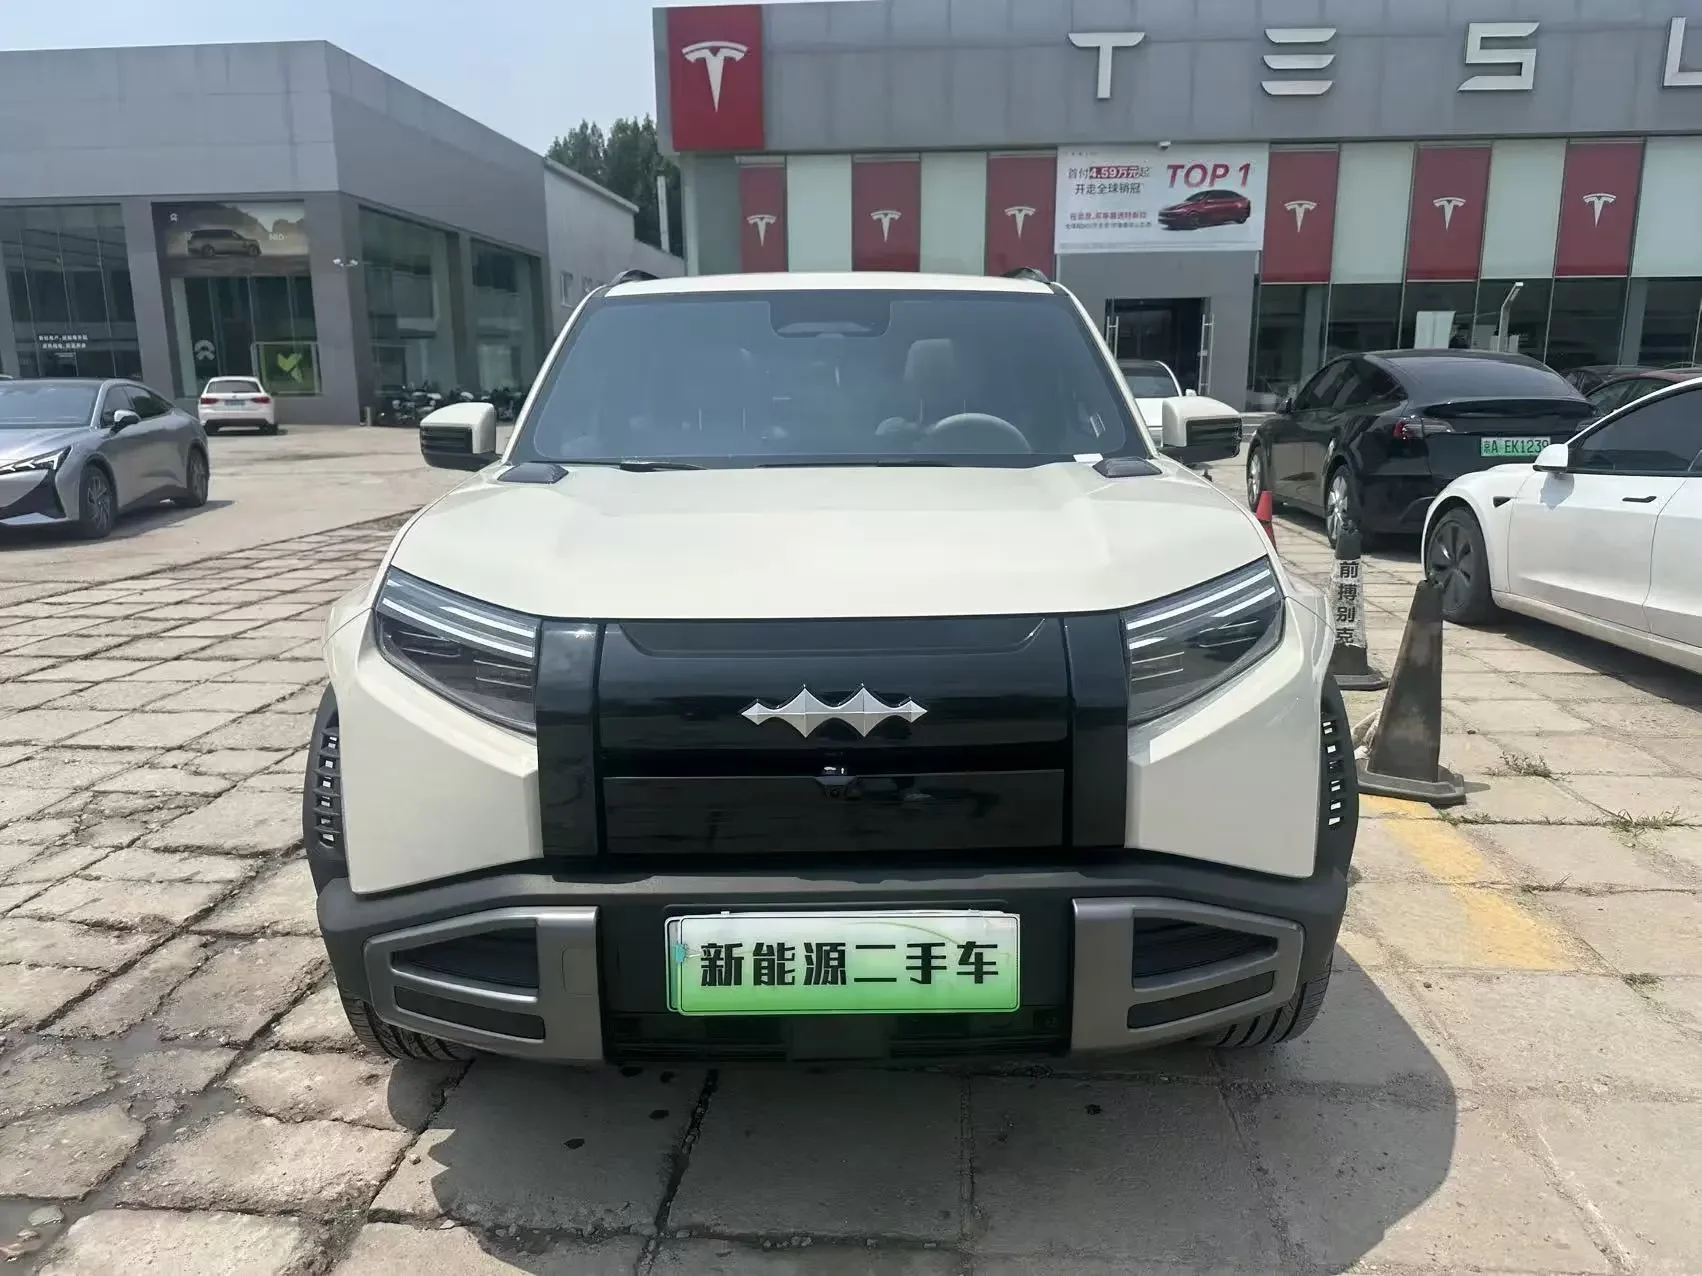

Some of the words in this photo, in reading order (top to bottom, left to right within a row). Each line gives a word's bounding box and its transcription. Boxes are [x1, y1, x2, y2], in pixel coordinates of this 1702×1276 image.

[1166, 163, 1230, 189] TOP
[1238, 163, 1251, 188] 1
[700, 940, 999, 987] 新能源二手车
